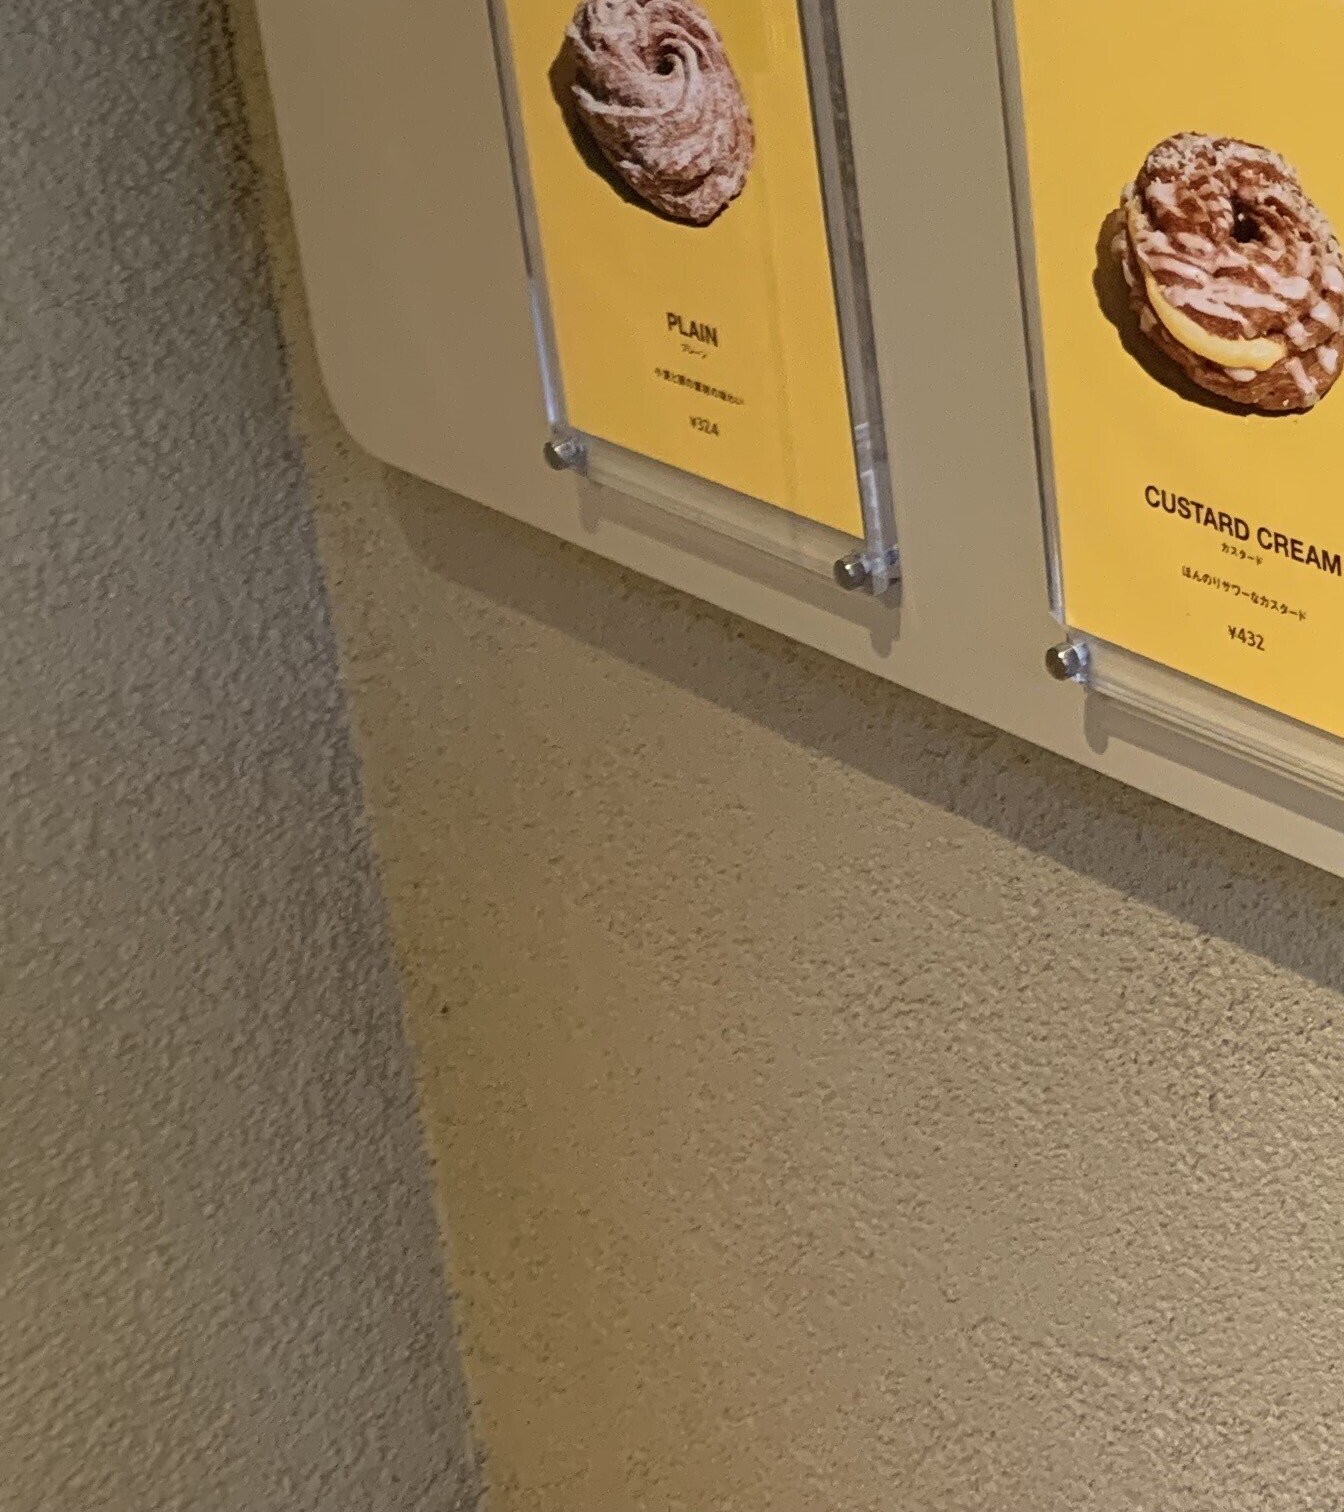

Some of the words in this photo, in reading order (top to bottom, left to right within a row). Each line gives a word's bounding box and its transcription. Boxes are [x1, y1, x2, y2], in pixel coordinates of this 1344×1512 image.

[666, 312, 718, 348] PLAIN
[1144, 485, 1250, 541] CUSTARD
[1256, 526, 1343, 577] CREAM
[1221, 542, 1263, 566] カスタード
[1227, 625, 1265, 652] ¥432
